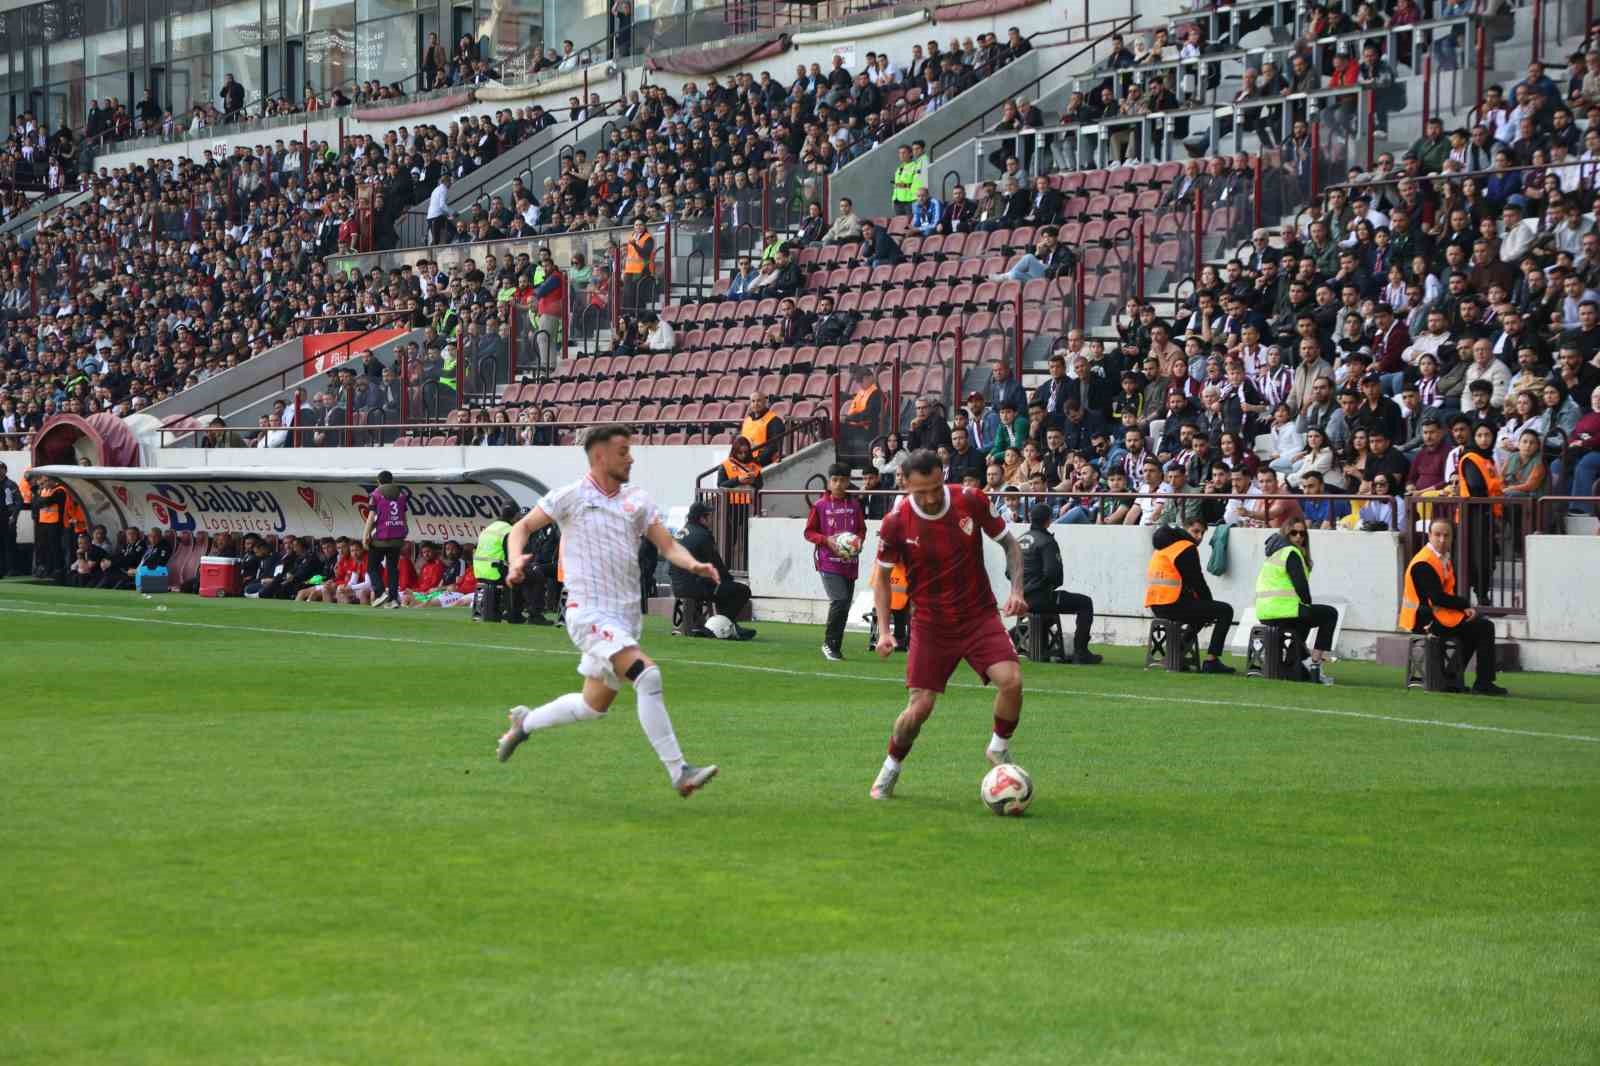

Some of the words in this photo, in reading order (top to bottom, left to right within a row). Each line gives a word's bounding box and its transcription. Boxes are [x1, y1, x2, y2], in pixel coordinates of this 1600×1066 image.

[390, 501, 399, 515] 3
[201, 513, 271, 534] Logistics
[416, 519, 486, 540] Logisti
